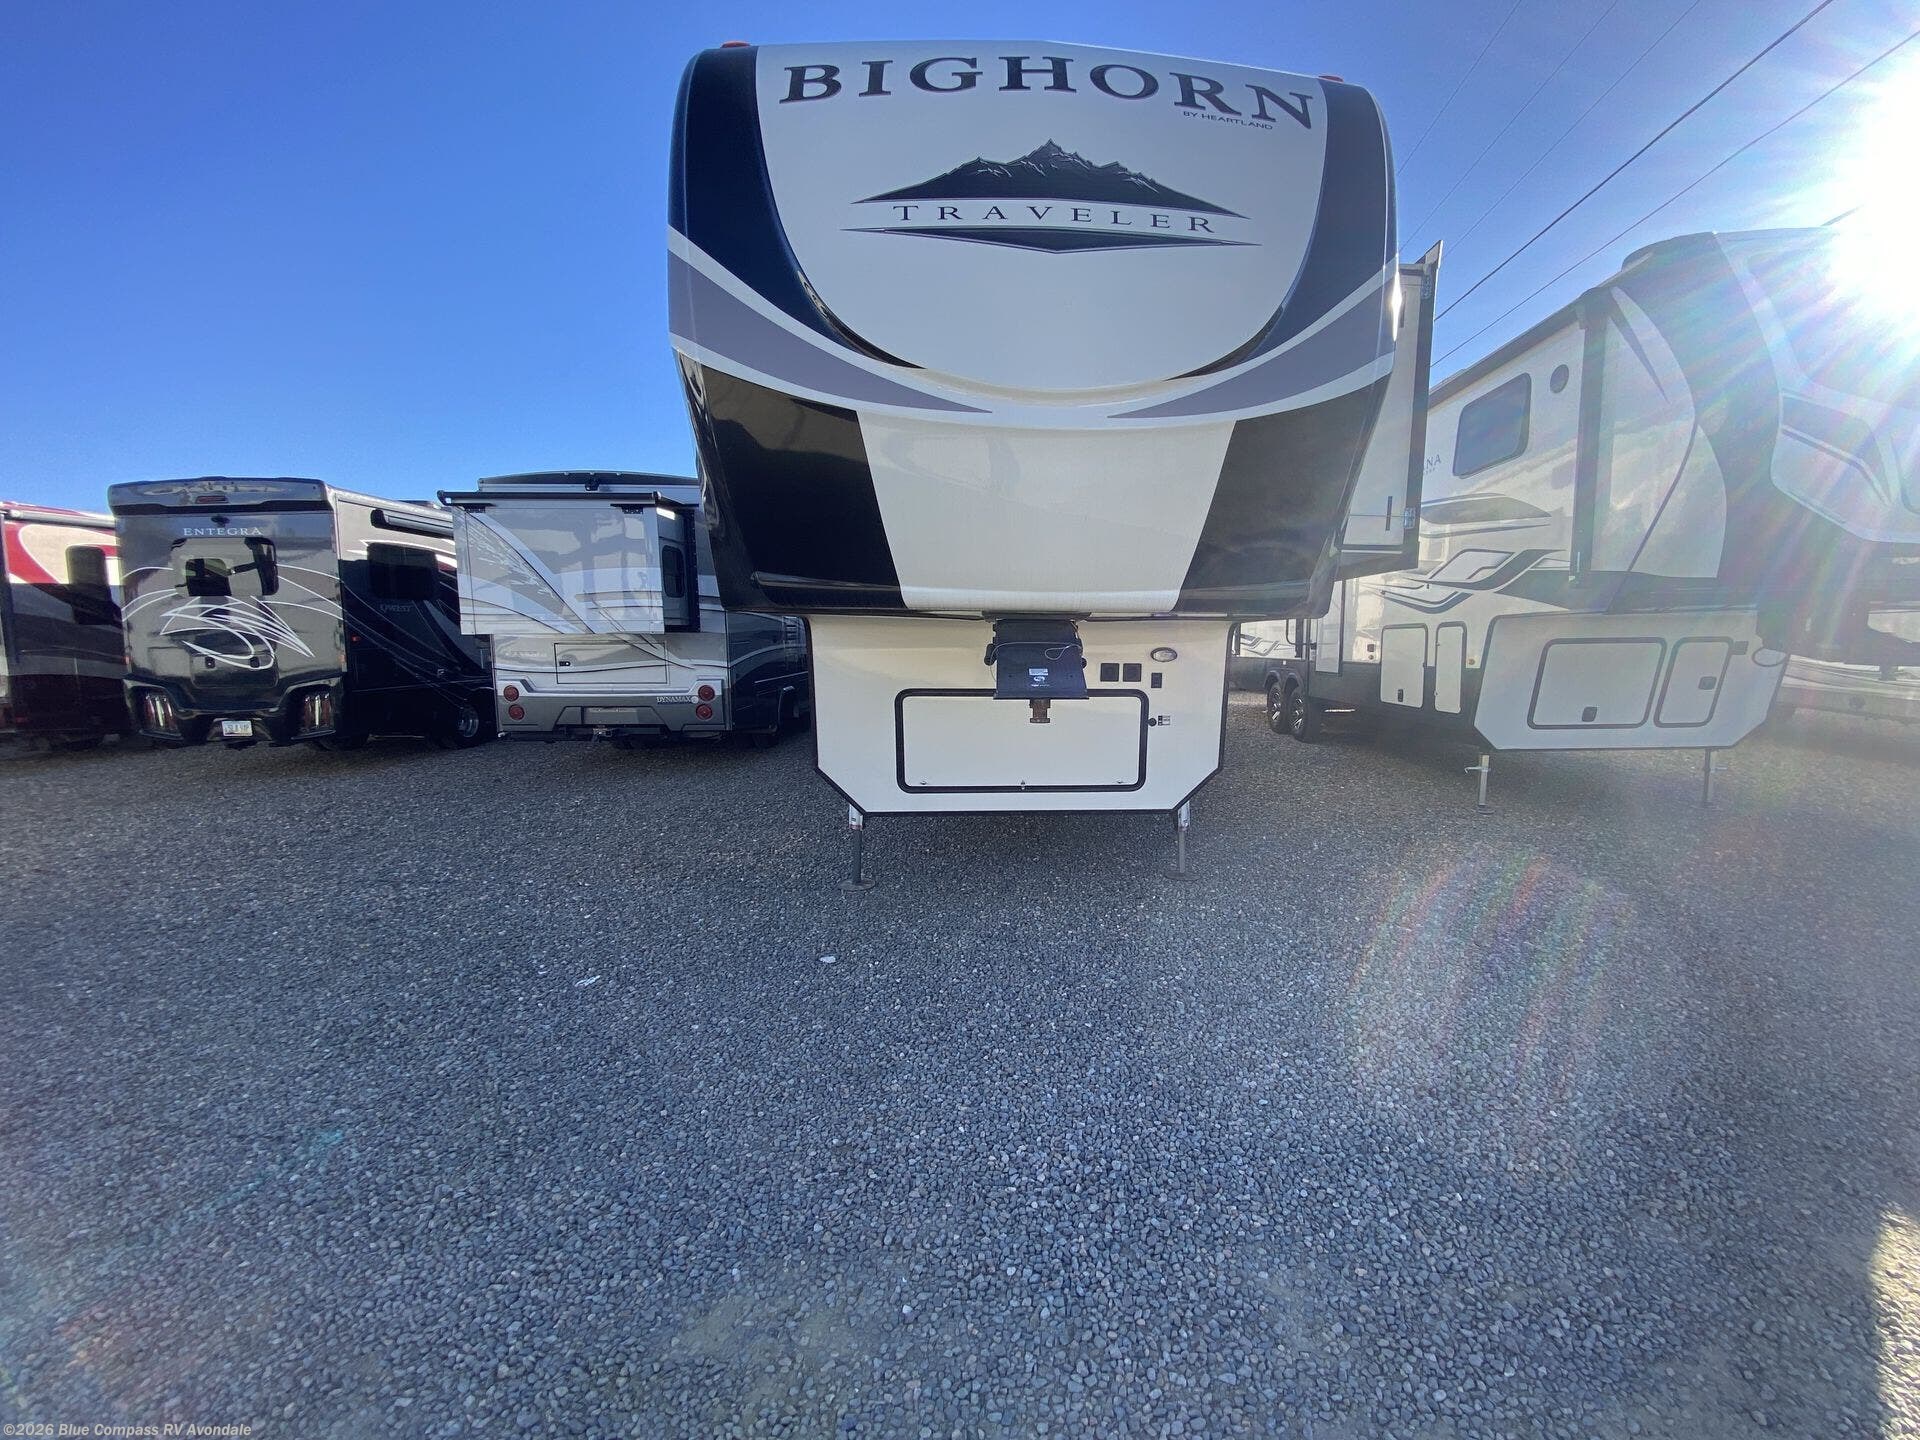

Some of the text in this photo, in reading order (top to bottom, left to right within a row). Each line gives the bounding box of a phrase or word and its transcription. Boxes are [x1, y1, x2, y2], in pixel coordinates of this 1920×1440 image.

[779, 56, 1315, 131] BIGHORN
[1201, 113, 1273, 129] HEARTLAND
[892, 204, 1217, 234] TRAVELER
[183, 526, 264, 536] ENTEGRA
